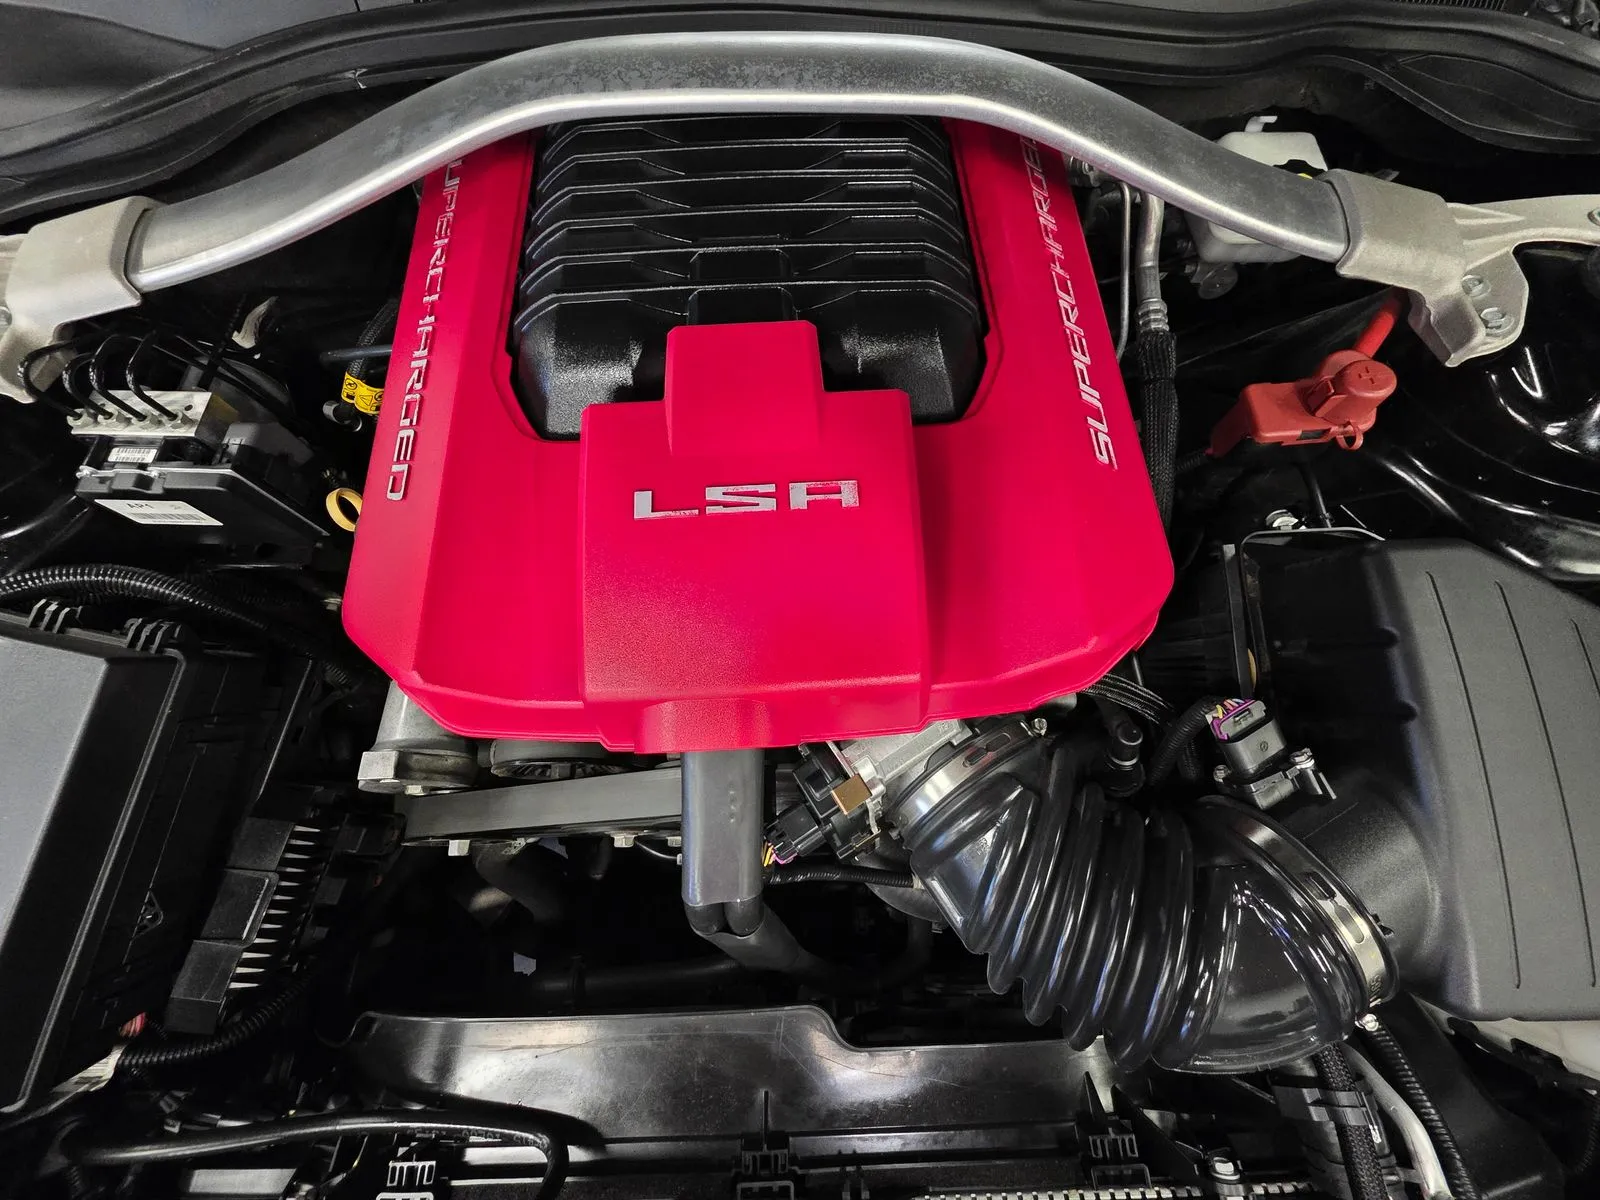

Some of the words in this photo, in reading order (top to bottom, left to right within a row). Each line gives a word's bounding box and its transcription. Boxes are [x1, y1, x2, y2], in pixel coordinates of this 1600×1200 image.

[387, 158, 463, 500] UPERCHARGED
[1019, 135, 1118, 470] SUPERCHARGE
[633, 479, 861, 520] LSA
